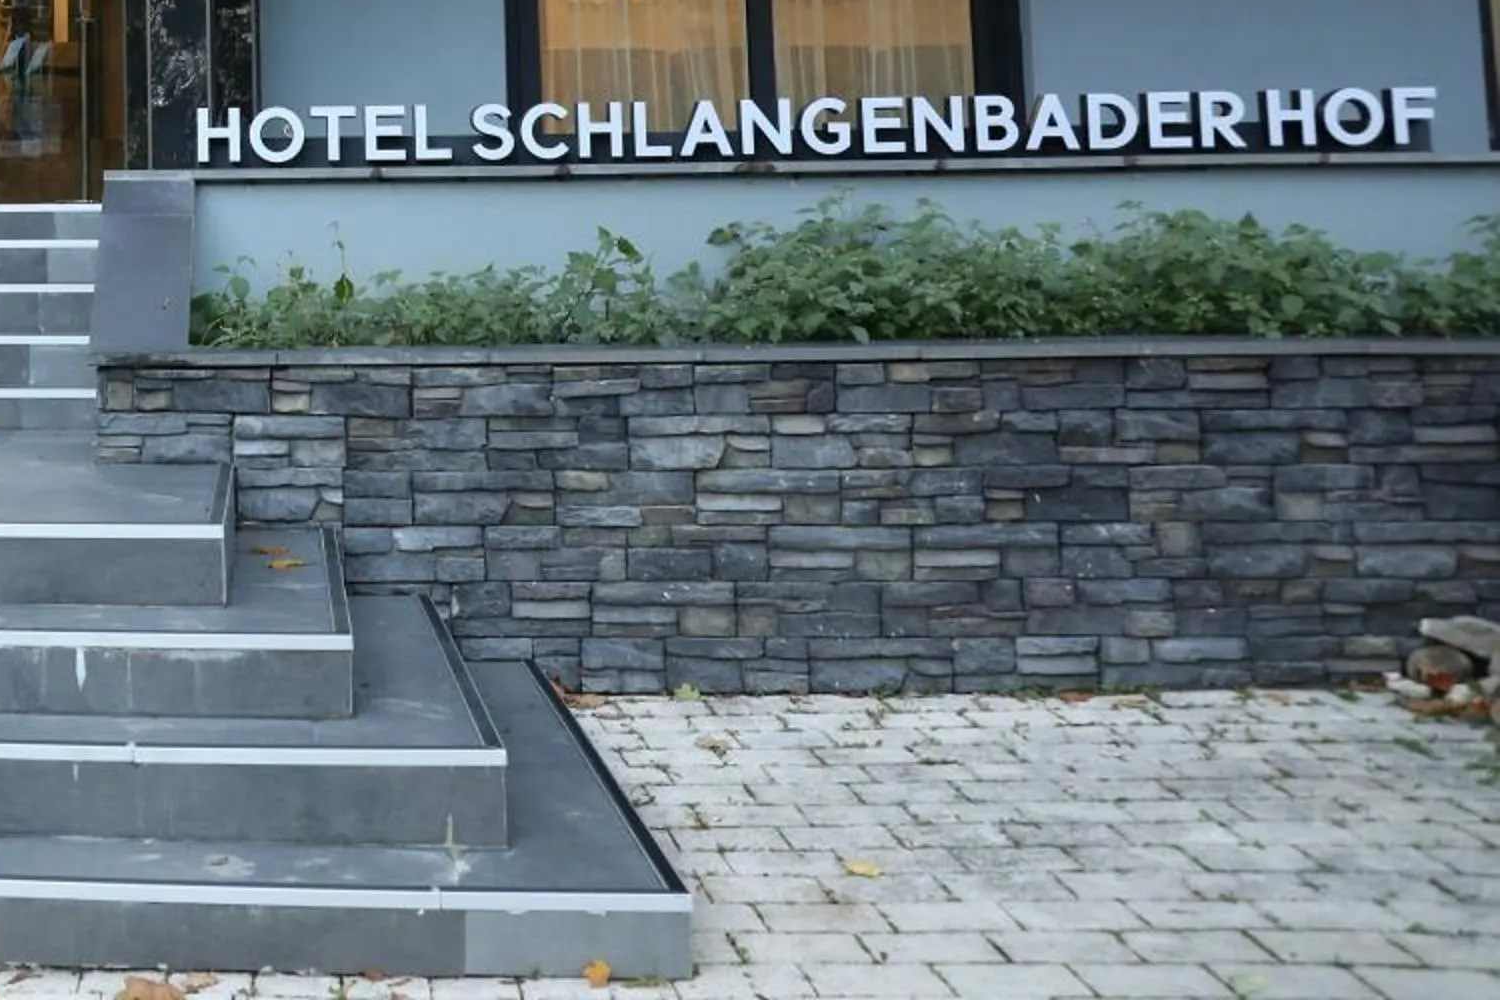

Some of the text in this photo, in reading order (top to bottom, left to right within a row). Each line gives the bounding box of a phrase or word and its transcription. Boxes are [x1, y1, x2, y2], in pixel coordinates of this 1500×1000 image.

[197, 87, 1438, 163] HOTEL SCHLANGENBADER HOF
